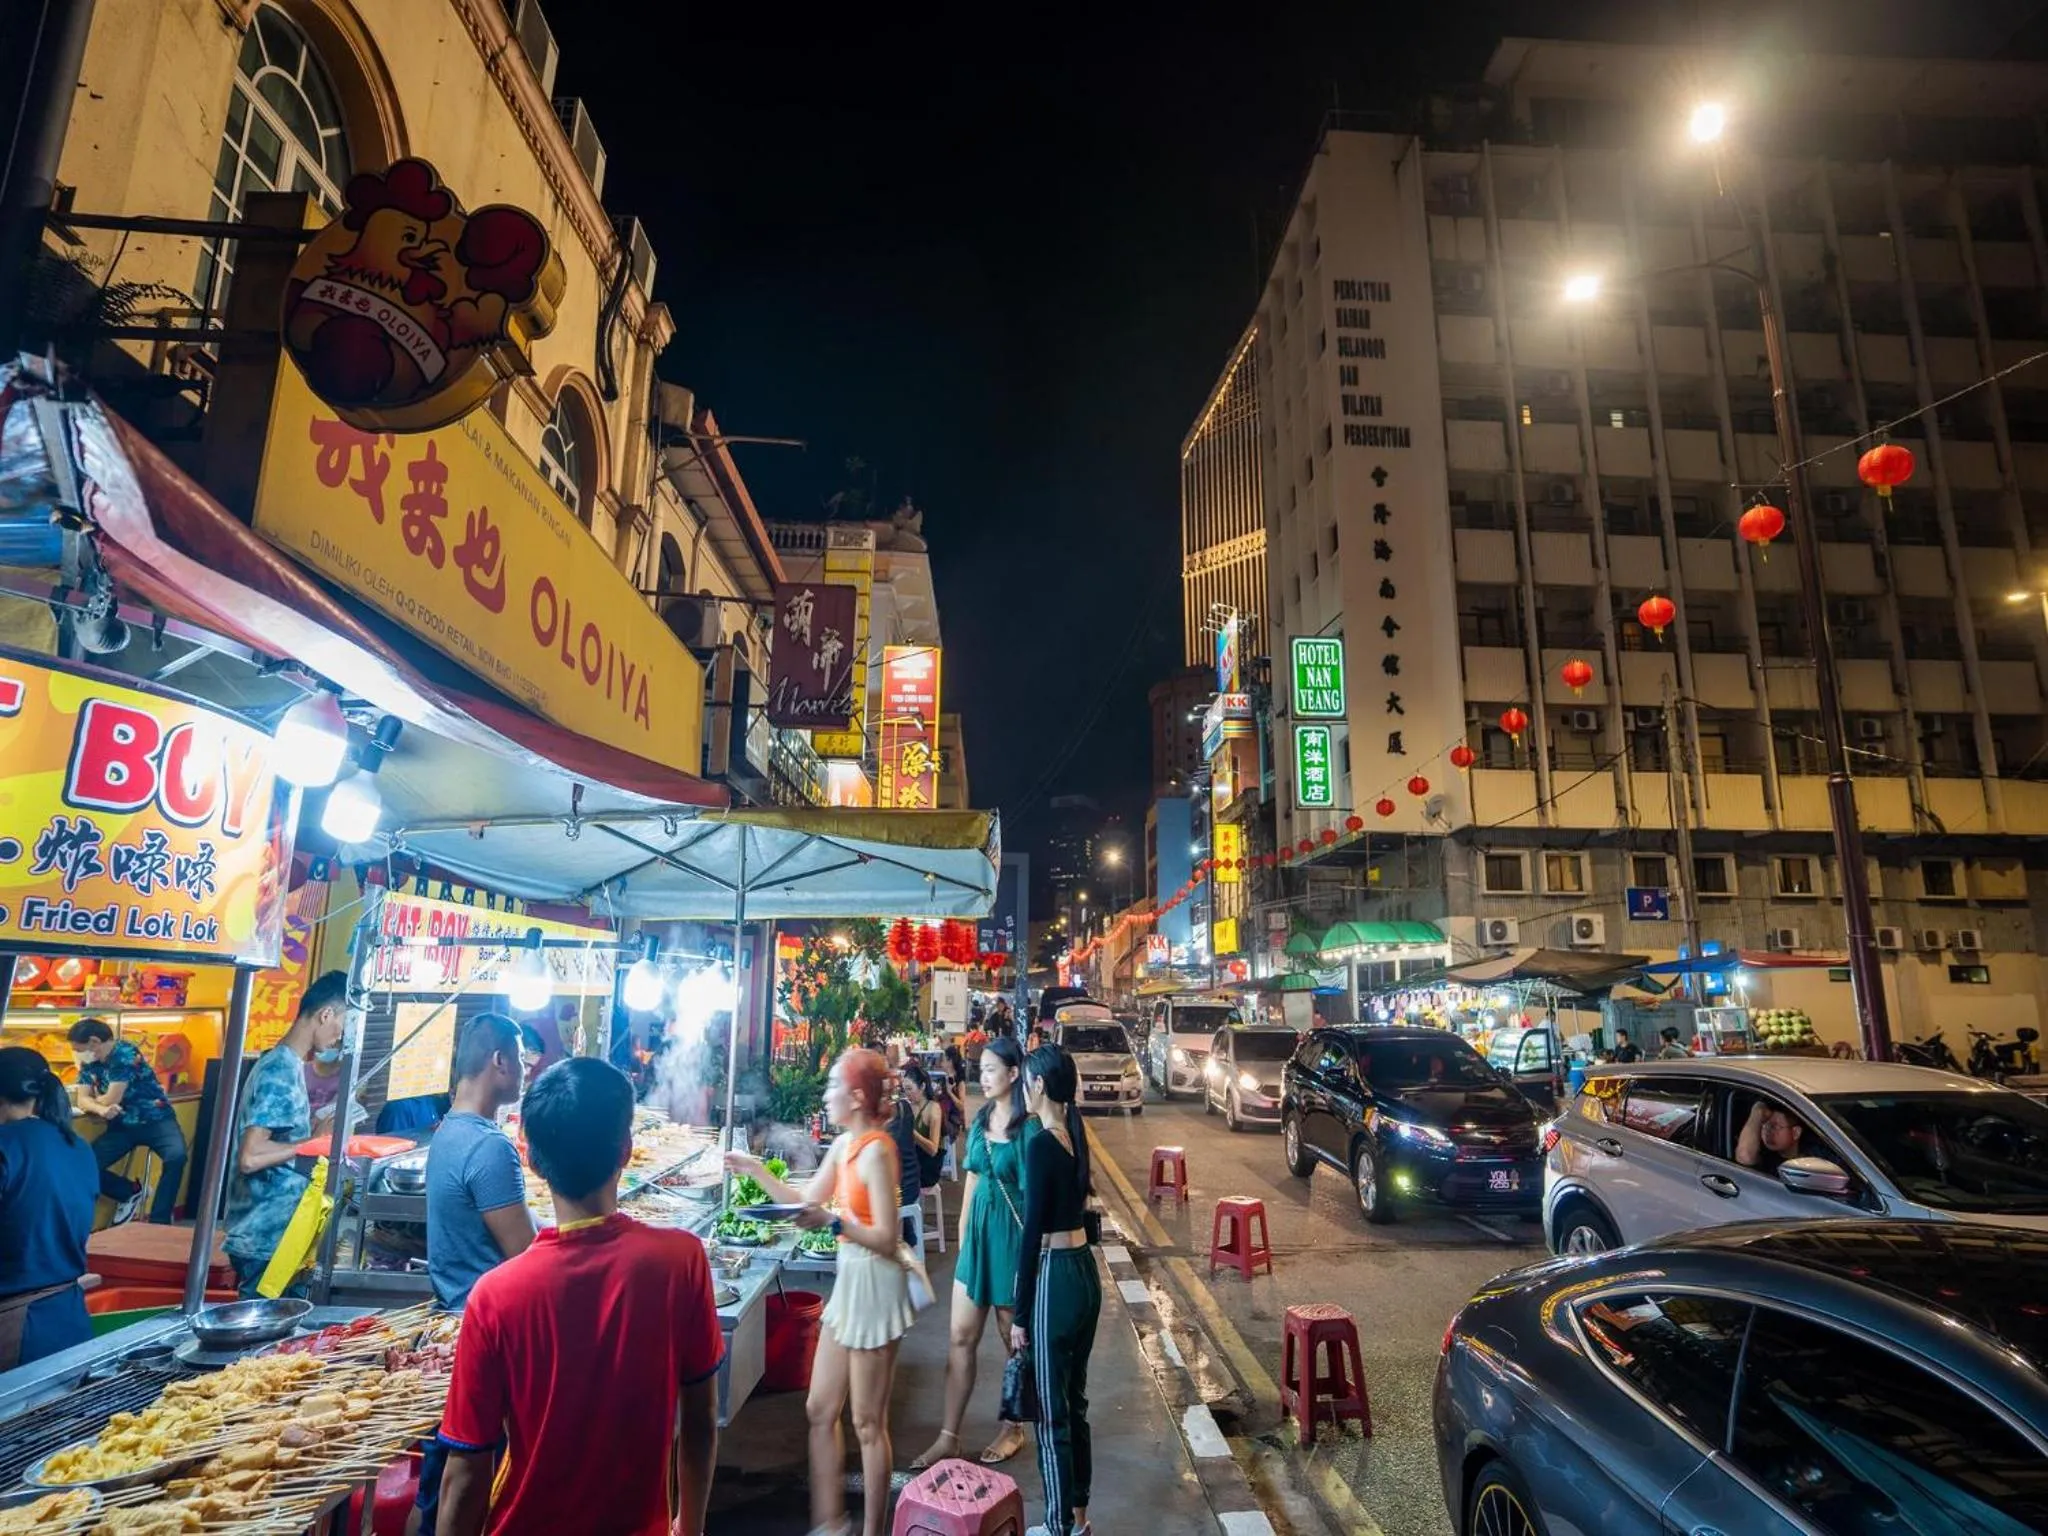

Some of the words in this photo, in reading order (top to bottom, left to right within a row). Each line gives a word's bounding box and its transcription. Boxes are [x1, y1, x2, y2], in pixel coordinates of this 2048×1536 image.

[1334, 280, 1391, 302] PERSATUAN
[377, 308, 432, 362] OLOIYA
[484, 441, 493, 459] &
[494, 451, 541, 514] MAKANAN
[541, 504, 572, 550] RINGAN
[310, 529, 361, 577] DIMILIKI
[363, 567, 394, 597] OLEH
[417, 604, 446, 634] FOOD
[446, 624, 477, 658] RETAIL
[531, 576, 649, 731] OLOIYA
[1298, 644, 1339, 665] HOTEL
[1306, 666, 1332, 687] NAN
[1226, 696, 1247, 707] KK
[1299, 689, 1340, 710] YEANG
[1303, 731, 1326, 800] 南洋酒店
[1643, 895, 1652, 908] P
[20, 897, 118, 937] Fried
[125, 907, 176, 939] Lok
[181, 914, 219, 943] Lok
[1149, 935, 1167, 949] KK
